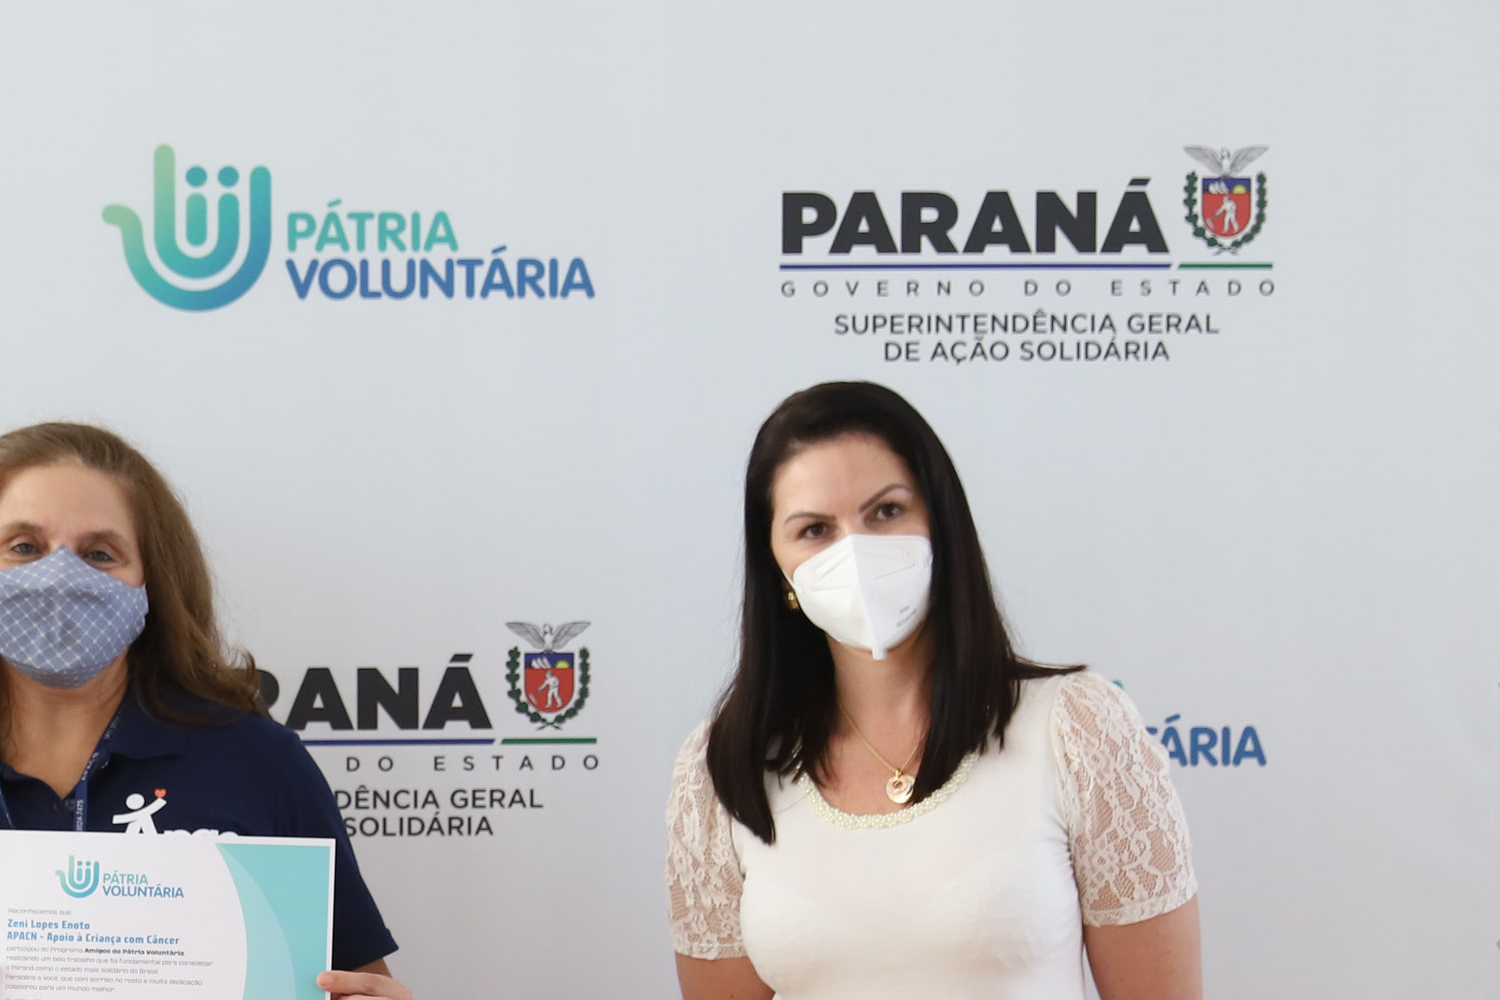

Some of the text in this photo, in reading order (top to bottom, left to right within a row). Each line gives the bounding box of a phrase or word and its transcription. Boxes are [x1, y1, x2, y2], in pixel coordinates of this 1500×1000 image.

[781, 178, 1170, 254] PARANÁ
[287, 199, 459, 253] PÁTRIA
[285, 245, 595, 300] VOLUNTÁRIA
[781, 279, 1275, 297] GOVERNO DO ESTADO
[834, 309, 1220, 335] SUPERINTENDÊNCIA GERAL
[884, 336, 1170, 365] DE AÇÃO SOLIDÁRIA
[346, 755, 598, 772] DO ESTADO
[450, 788, 544, 809] GERAL
[343, 811, 494, 837] SOLIDÁRIA
[103, 871, 149, 885] PÁTRIA
[102, 882, 185, 899] VOLUNTÁRIA
[7, 918, 91, 931] Zeni Lopes Enoto
[7, 931, 37, 940] APACN
[47, 932, 74, 944] Apoio
[77, 932, 83, 942] à
[85, 933, 122, 945] Criança
[124, 936, 144, 944] com
[147, 934, 180, 945] Câncer
[146, 948, 185, 956] Voluntária
